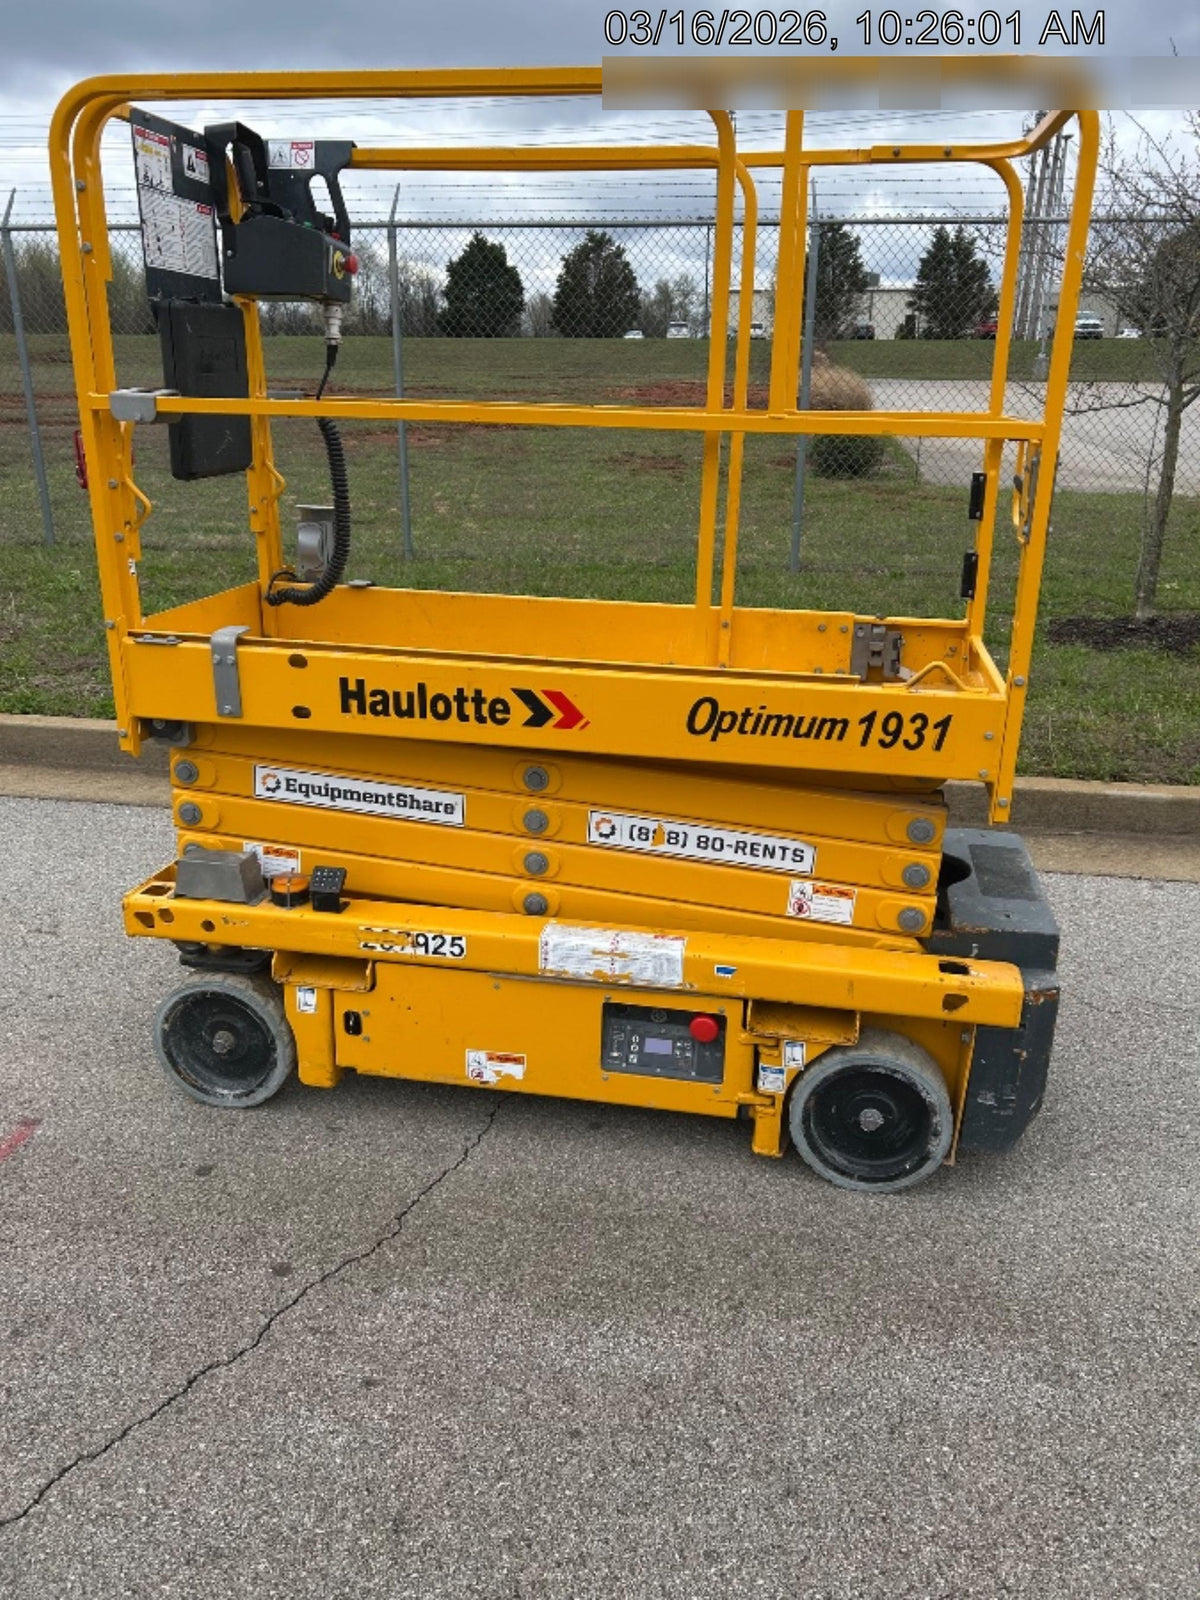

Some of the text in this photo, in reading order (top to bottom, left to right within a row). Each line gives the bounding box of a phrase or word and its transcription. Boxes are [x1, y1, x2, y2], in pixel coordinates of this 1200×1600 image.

[338, 676, 511, 726] Haulotte
[686, 696, 954, 752] Optimum 1931
[284, 777, 456, 816] EquipmentShare
[628, 824, 805, 864] (88) 80-RENTS
